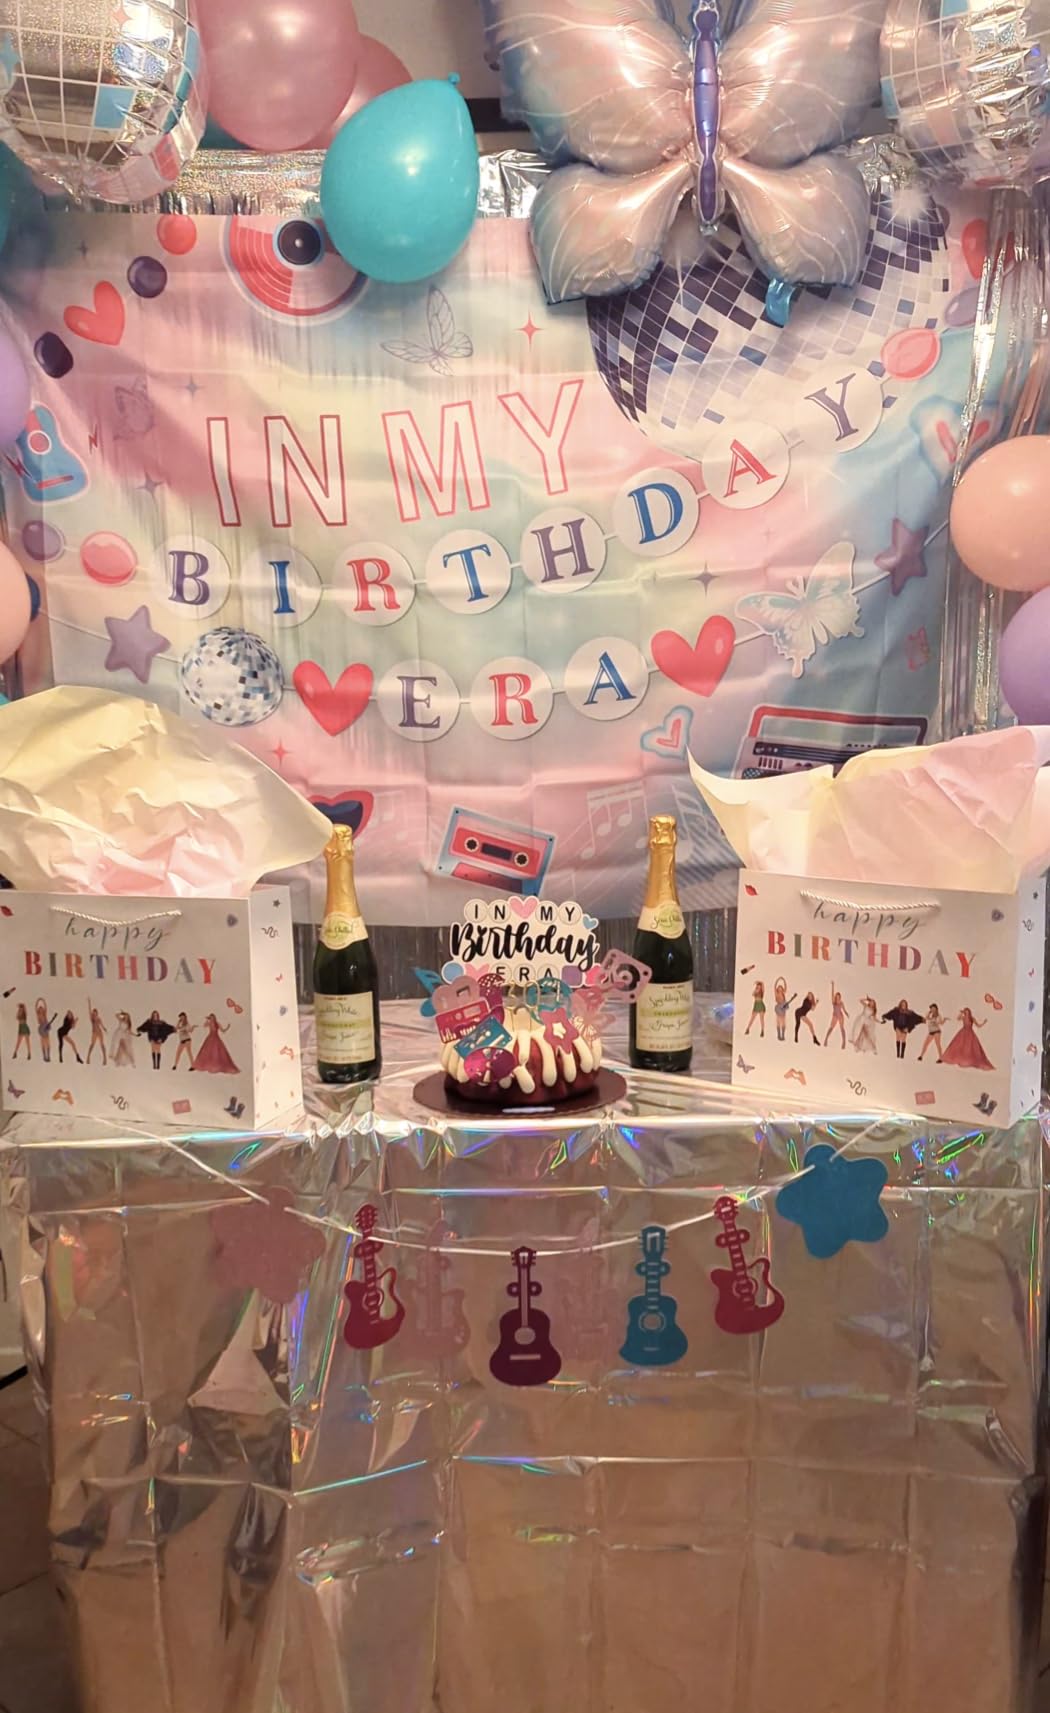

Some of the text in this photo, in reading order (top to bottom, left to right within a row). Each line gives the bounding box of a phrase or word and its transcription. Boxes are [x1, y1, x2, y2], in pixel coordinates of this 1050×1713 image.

[206, 379, 584, 528] IN MY
[168, 373, 859, 614] BIRTHDAY
[396, 651, 637, 728] ERA
[65, 917, 167, 951] happy
[474, 904, 575, 921] IN MY
[813, 902, 922, 940] happy
[24, 950, 216, 985] BIRTHDAY
[451, 922, 599, 972] Birthday
[767, 930, 976, 978] BIRTHDAY
